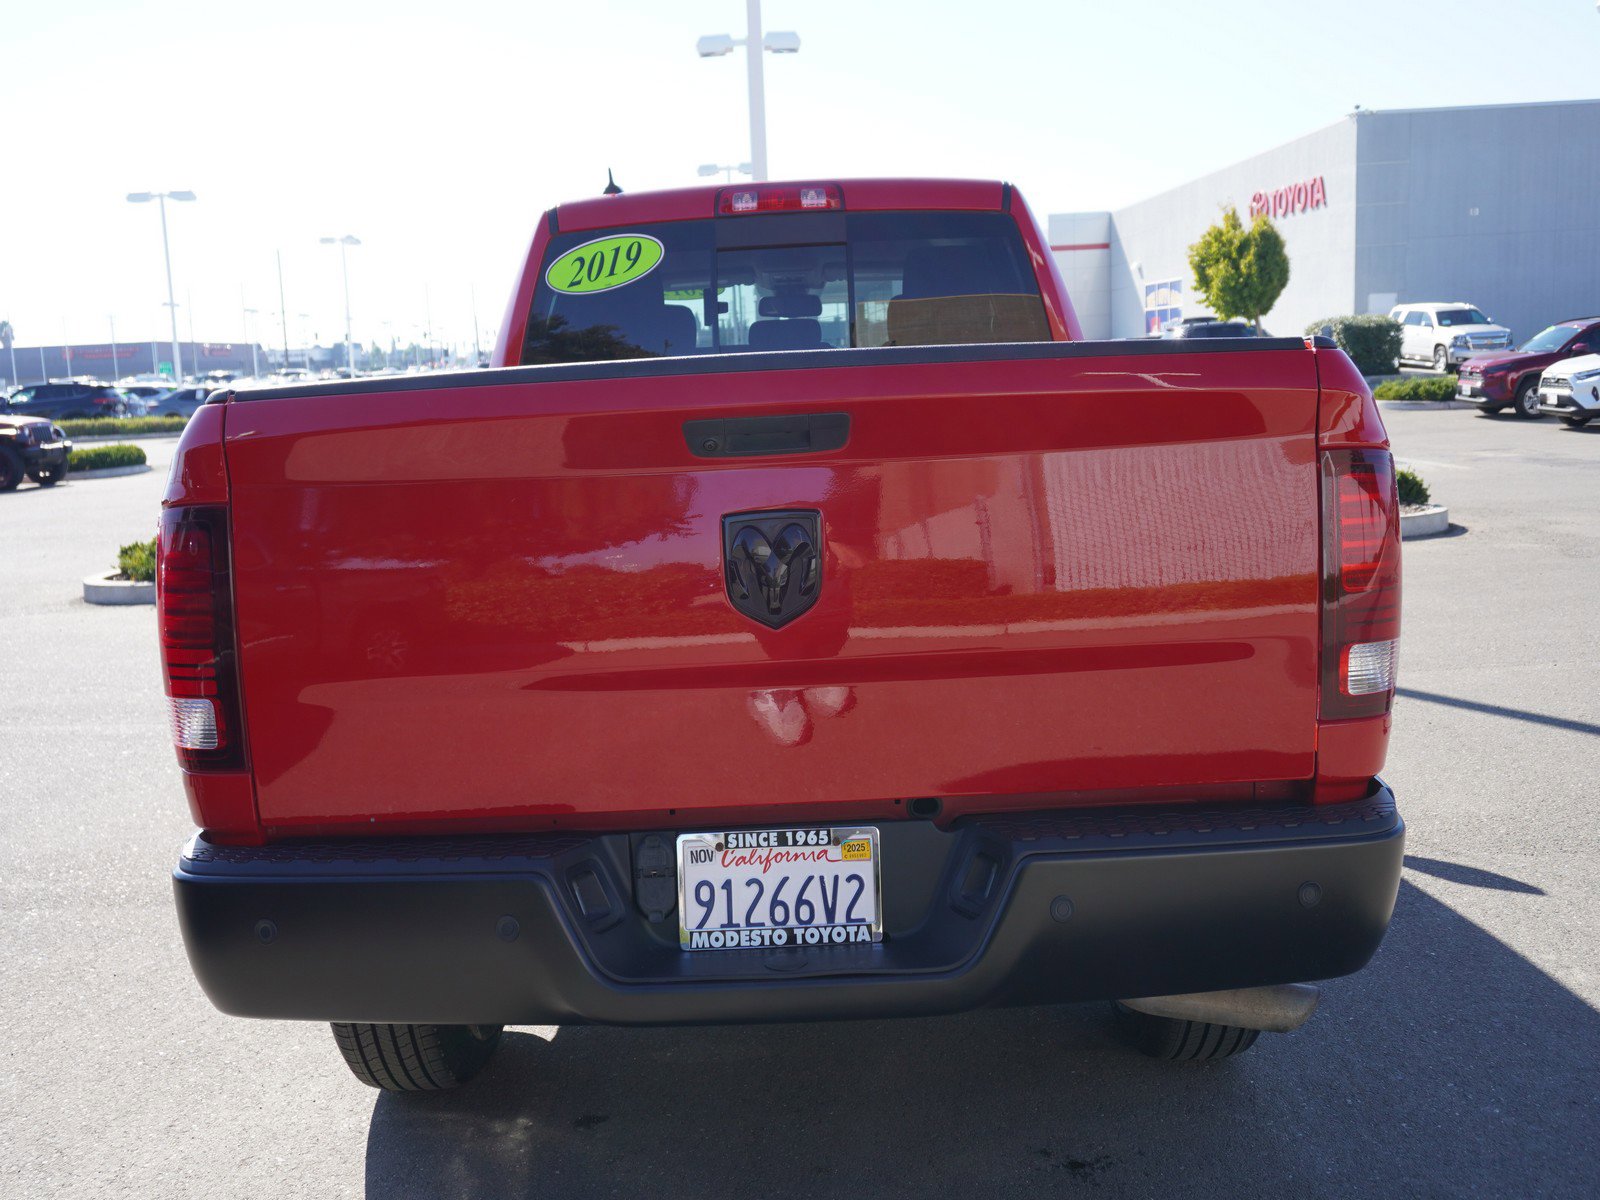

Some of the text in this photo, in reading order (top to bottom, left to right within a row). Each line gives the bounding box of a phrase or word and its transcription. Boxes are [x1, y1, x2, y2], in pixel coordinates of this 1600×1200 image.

[1270, 175, 1327, 219] TOYOTA
[567, 240, 642, 288] 2019
[727, 830, 829, 849] SINCE 1965
[846, 842, 866, 853] 2025
[690, 848, 715, 865] NOV
[721, 848, 842, 874] California
[694, 873, 867, 930] 91266V2
[691, 925, 871, 949] MODESTO TOYOTA
